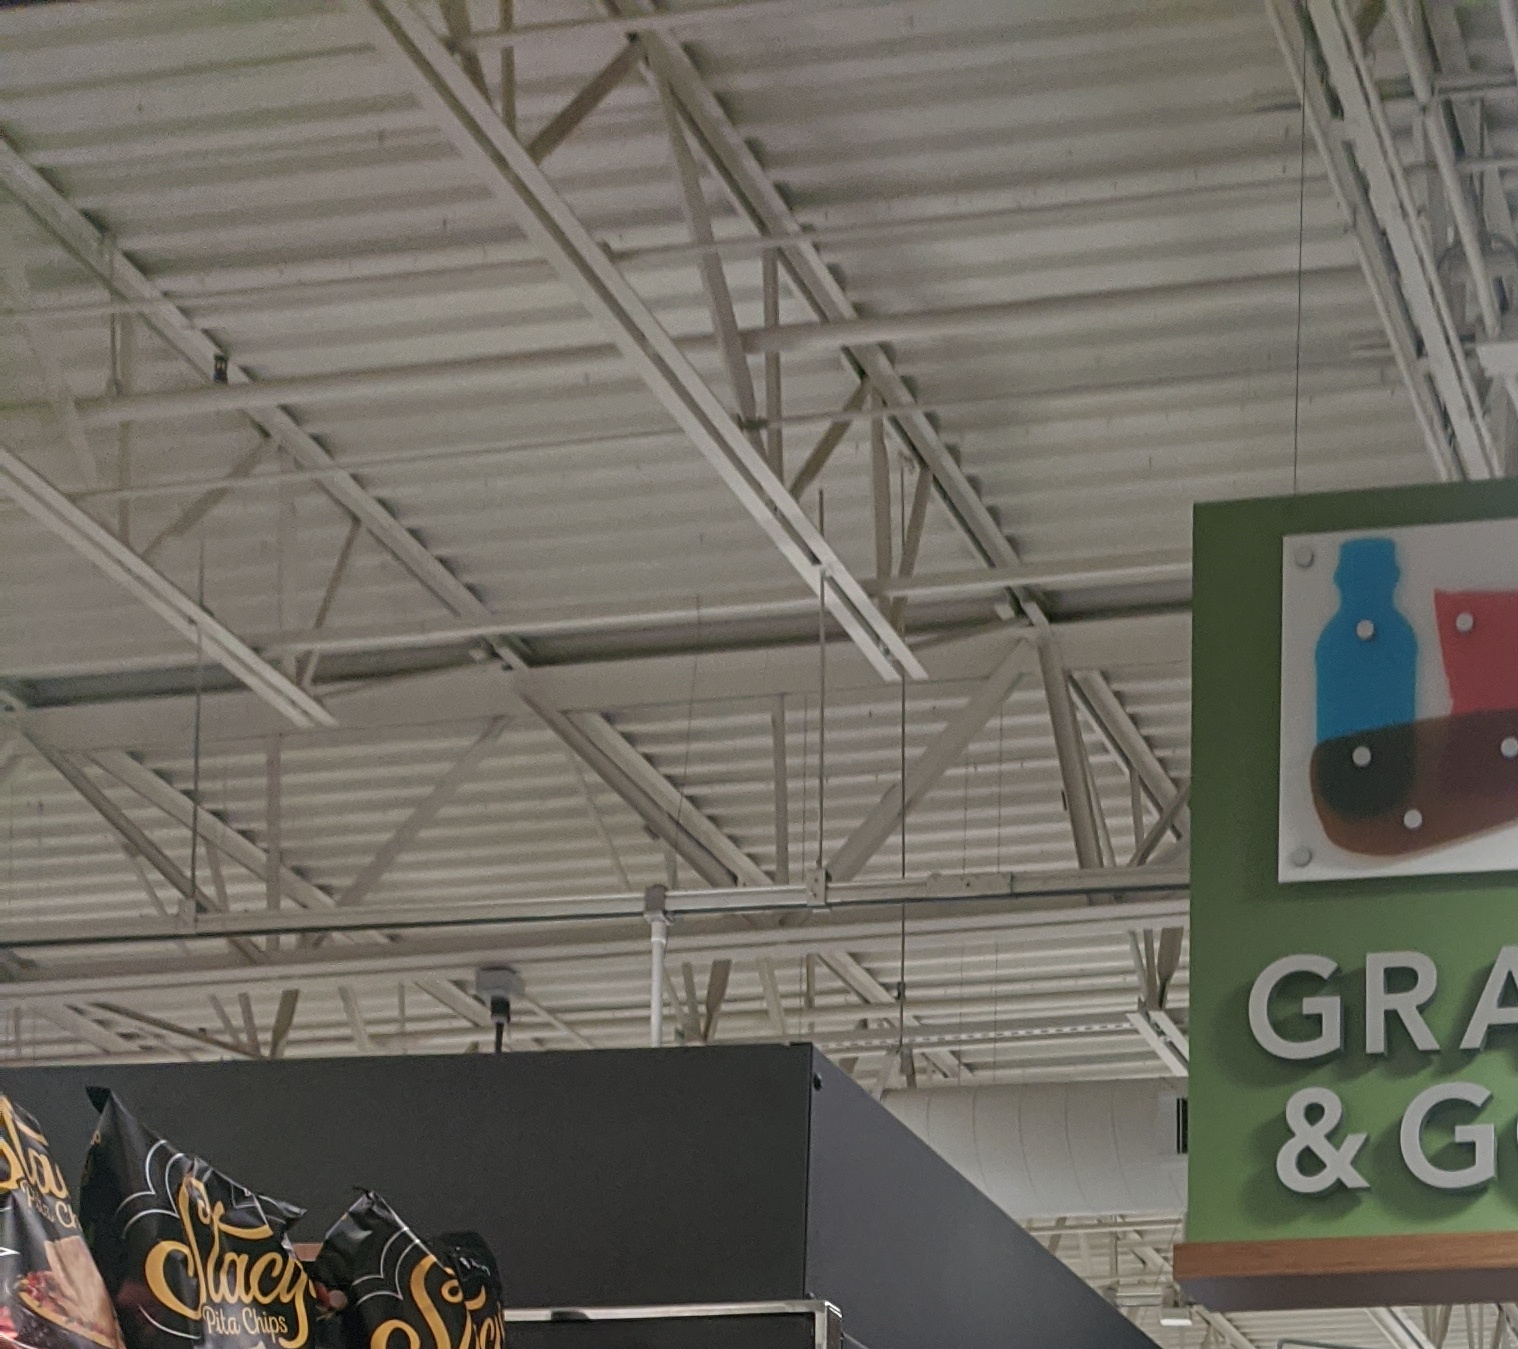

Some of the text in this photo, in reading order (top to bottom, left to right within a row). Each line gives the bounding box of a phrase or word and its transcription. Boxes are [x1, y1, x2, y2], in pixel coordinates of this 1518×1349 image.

[1276, 1087, 1371, 1194] &
[203, 1305, 288, 1343] Pita Chips
